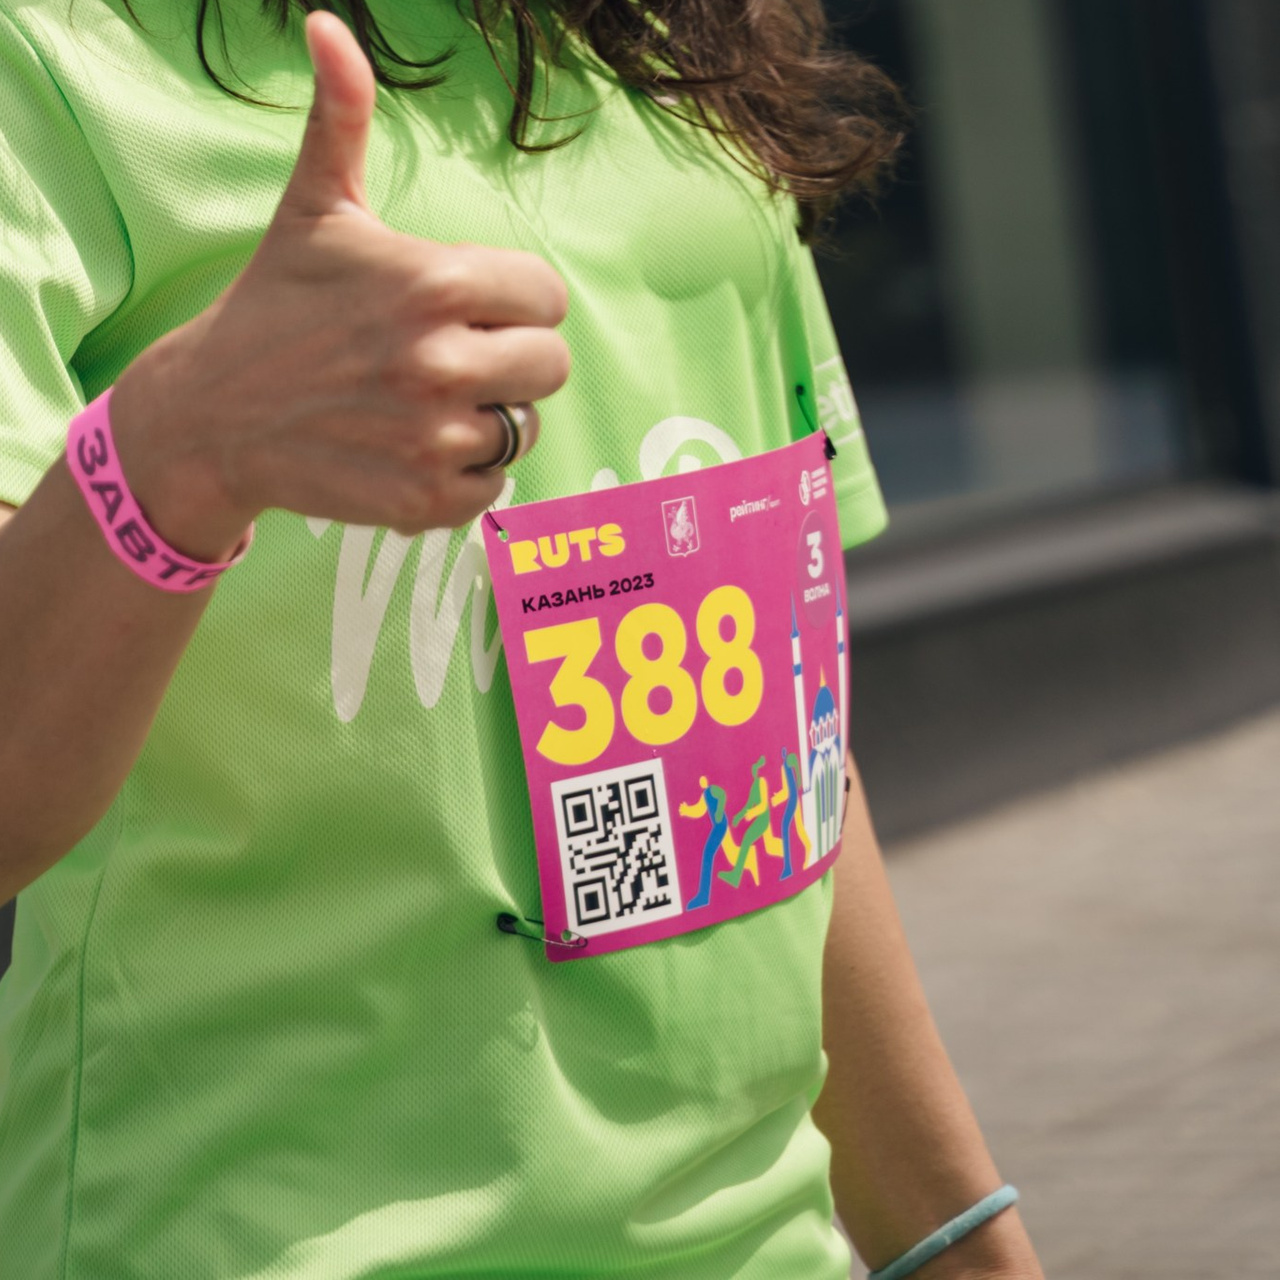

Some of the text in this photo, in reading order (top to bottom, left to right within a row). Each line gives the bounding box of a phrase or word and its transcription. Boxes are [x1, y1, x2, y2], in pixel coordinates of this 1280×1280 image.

[509, 523, 626, 575] RUTS
[806, 531, 824, 579] 3
[522, 573, 655, 614] КАЗАНЬ 2023
[803, 583, 831, 603] ВОЛНА
[522, 584, 764, 767] 388
